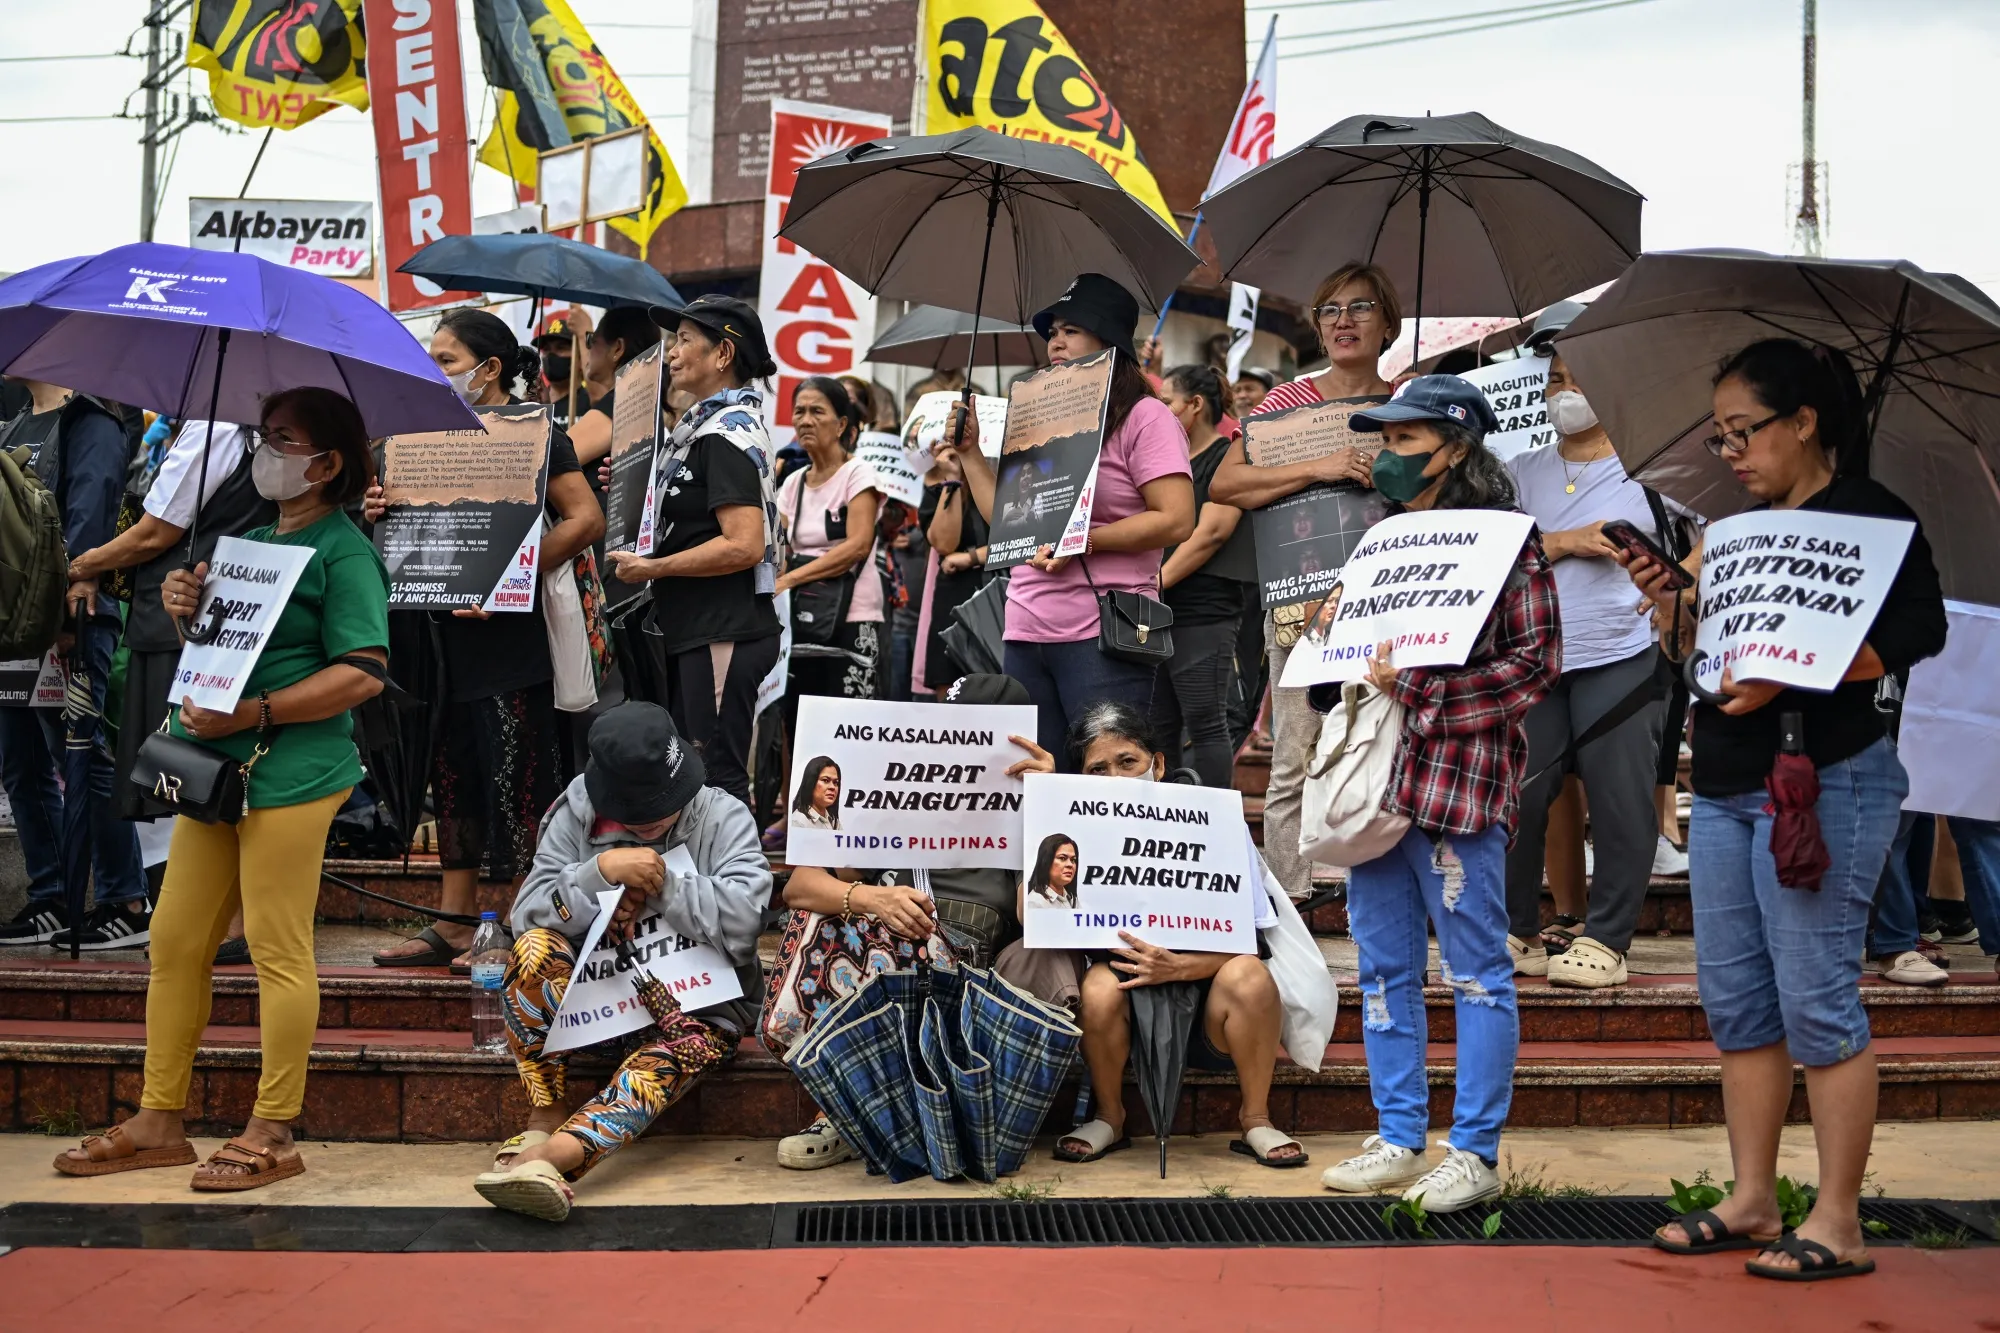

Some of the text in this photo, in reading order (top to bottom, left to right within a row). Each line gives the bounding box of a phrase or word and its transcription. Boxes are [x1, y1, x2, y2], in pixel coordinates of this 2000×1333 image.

[197, 210, 368, 245] Akbayan
[289, 246, 365, 269] Party
[128, 267, 228, 283] BARANGAY SAUYO
[1481, 373, 1544, 395] NAGUTIN
[1260, 444, 1286, 454] Including
[1299, 434, 1335, 445] Commission
[1272, 434, 1293, 443] Totality
[1305, 425, 1344, 436] Respondent's
[862, 454, 900, 464] APAT
[1261, 453, 1281, 462] Display
[1283, 446, 1307, 456] Conduct
[1309, 440, 1346, 451] Constituting
[1288, 453, 1316, 463] Violations
[1005, 535, 1036, 550] I-DISMISS!
[1351, 532, 1479, 563] ANG KASALANAN
[1701, 534, 1862, 568] PANAGUTIN SI SARA
[987, 551, 1008, 564] ITULOY
[1008, 549, 1021, 560] ANG
[218, 561, 281, 585] KASALANAN
[1297, 566, 1345, 585] I-DISMIS
[1370, 563, 1459, 588] DAPAT
[1710, 555, 1866, 588] SA PITONG
[398, 582, 446, 593] I-DISMISS!
[404, 593, 483, 604] ANG PAGLILITIS!
[494, 592, 530, 603] KALIPUNAN
[1265, 585, 1306, 602] ITULOY
[1336, 589, 1485, 622] PANAGUTAN
[1700, 583, 1865, 623] KASALANAN
[1718, 611, 1787, 642] NIYA
[1322, 643, 1373, 663] TINDIG
[1723, 643, 1817, 667] PILIPINAS
[192, 672, 234, 690] PILIPINAS
[833, 724, 993, 746] ANG KASALANAN
[884, 762, 986, 784] DAPAT
[844, 789, 1024, 812] PANAGUTAN
[1068, 800, 1209, 826] ANG KASALANAN
[834, 835, 1008, 850] TINDIG PILIPINAS
[1121, 837, 1206, 862] DAPAT
[1082, 865, 1242, 894] PANAGUTAN
[1074, 914, 1233, 933] TINDIG PILIPINAS
[559, 1005, 614, 1029] TINDIG
